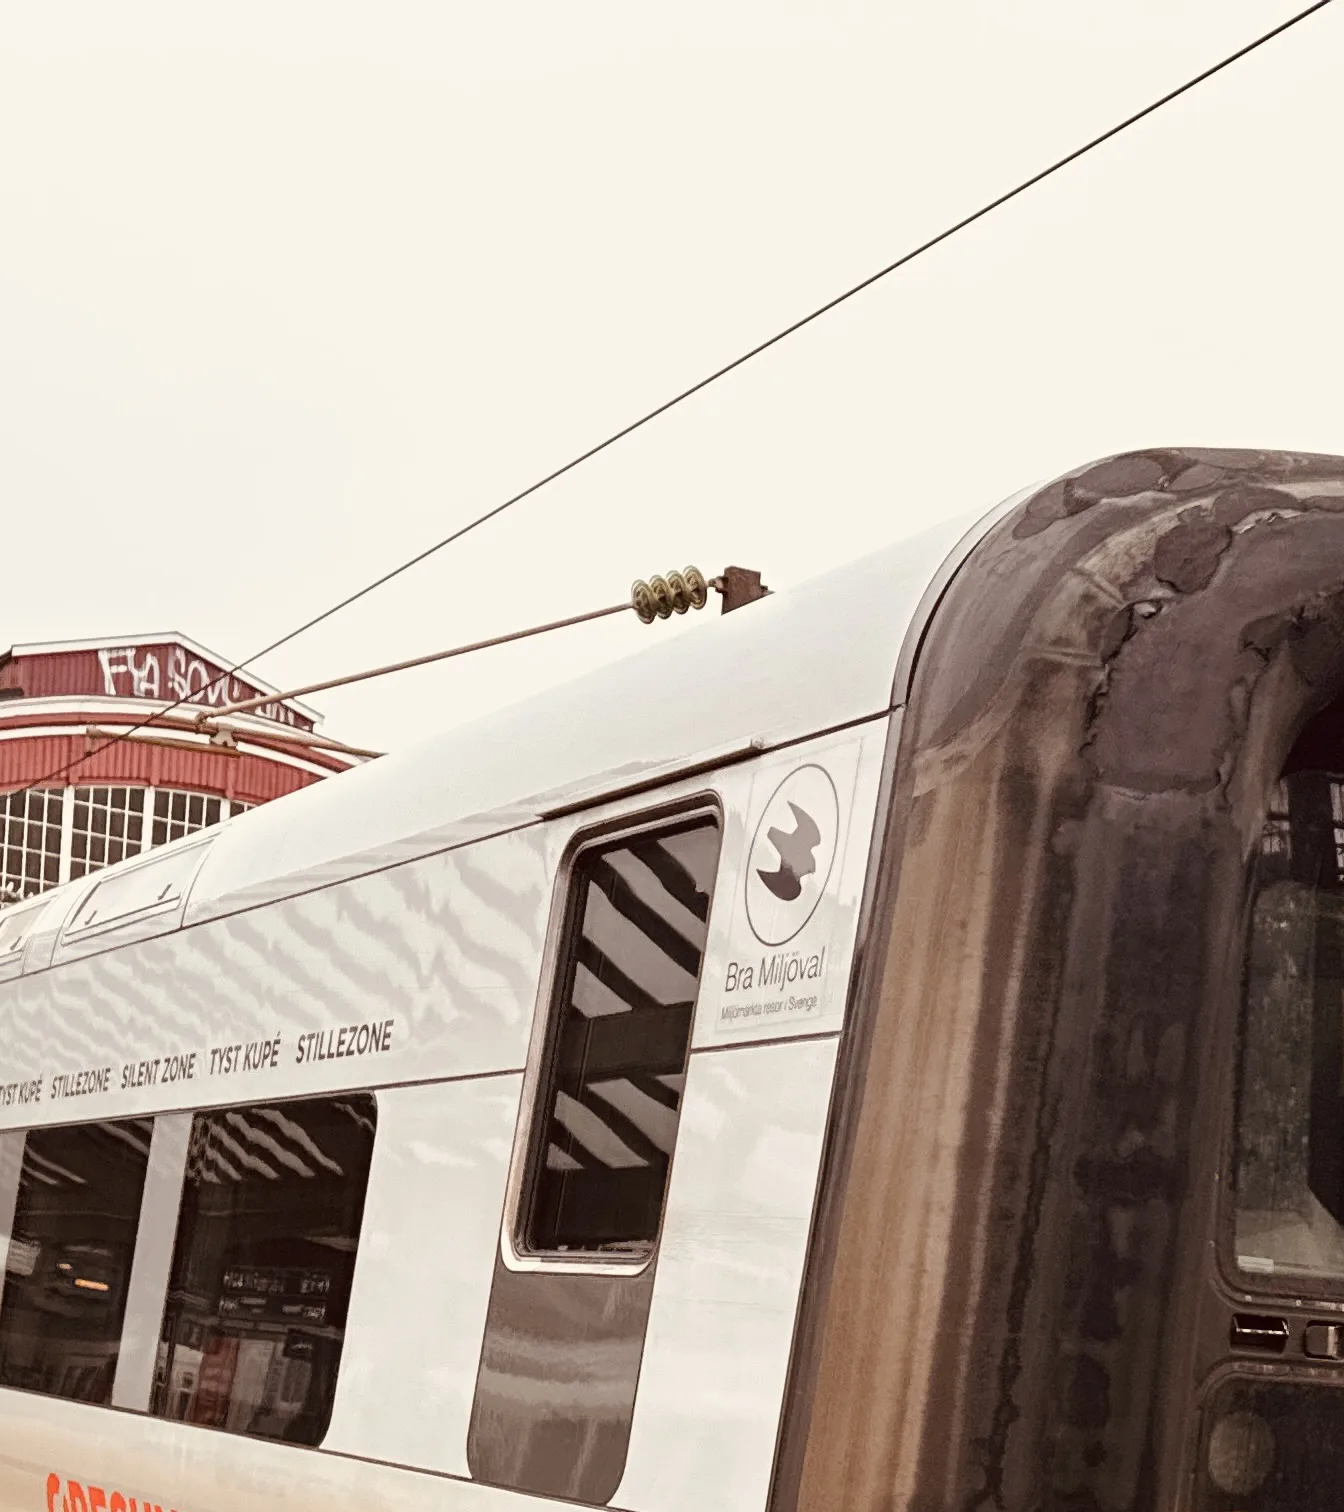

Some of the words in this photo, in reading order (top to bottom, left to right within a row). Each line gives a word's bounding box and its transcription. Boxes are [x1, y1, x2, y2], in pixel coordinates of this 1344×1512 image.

[724, 962, 753, 992] Bra
[758, 945, 825, 992] Miljöval
[17, 1073, 42, 1103] KUPÉ
[51, 1067, 111, 1100] STILLEZONE
[120, 1059, 160, 1090] SILENT
[161, 1053, 196, 1083] ZONE
[210, 1044, 242, 1075] TYST
[243, 1031, 282, 1071] KUPÉ
[296, 1019, 395, 1064] STILLEZONE
